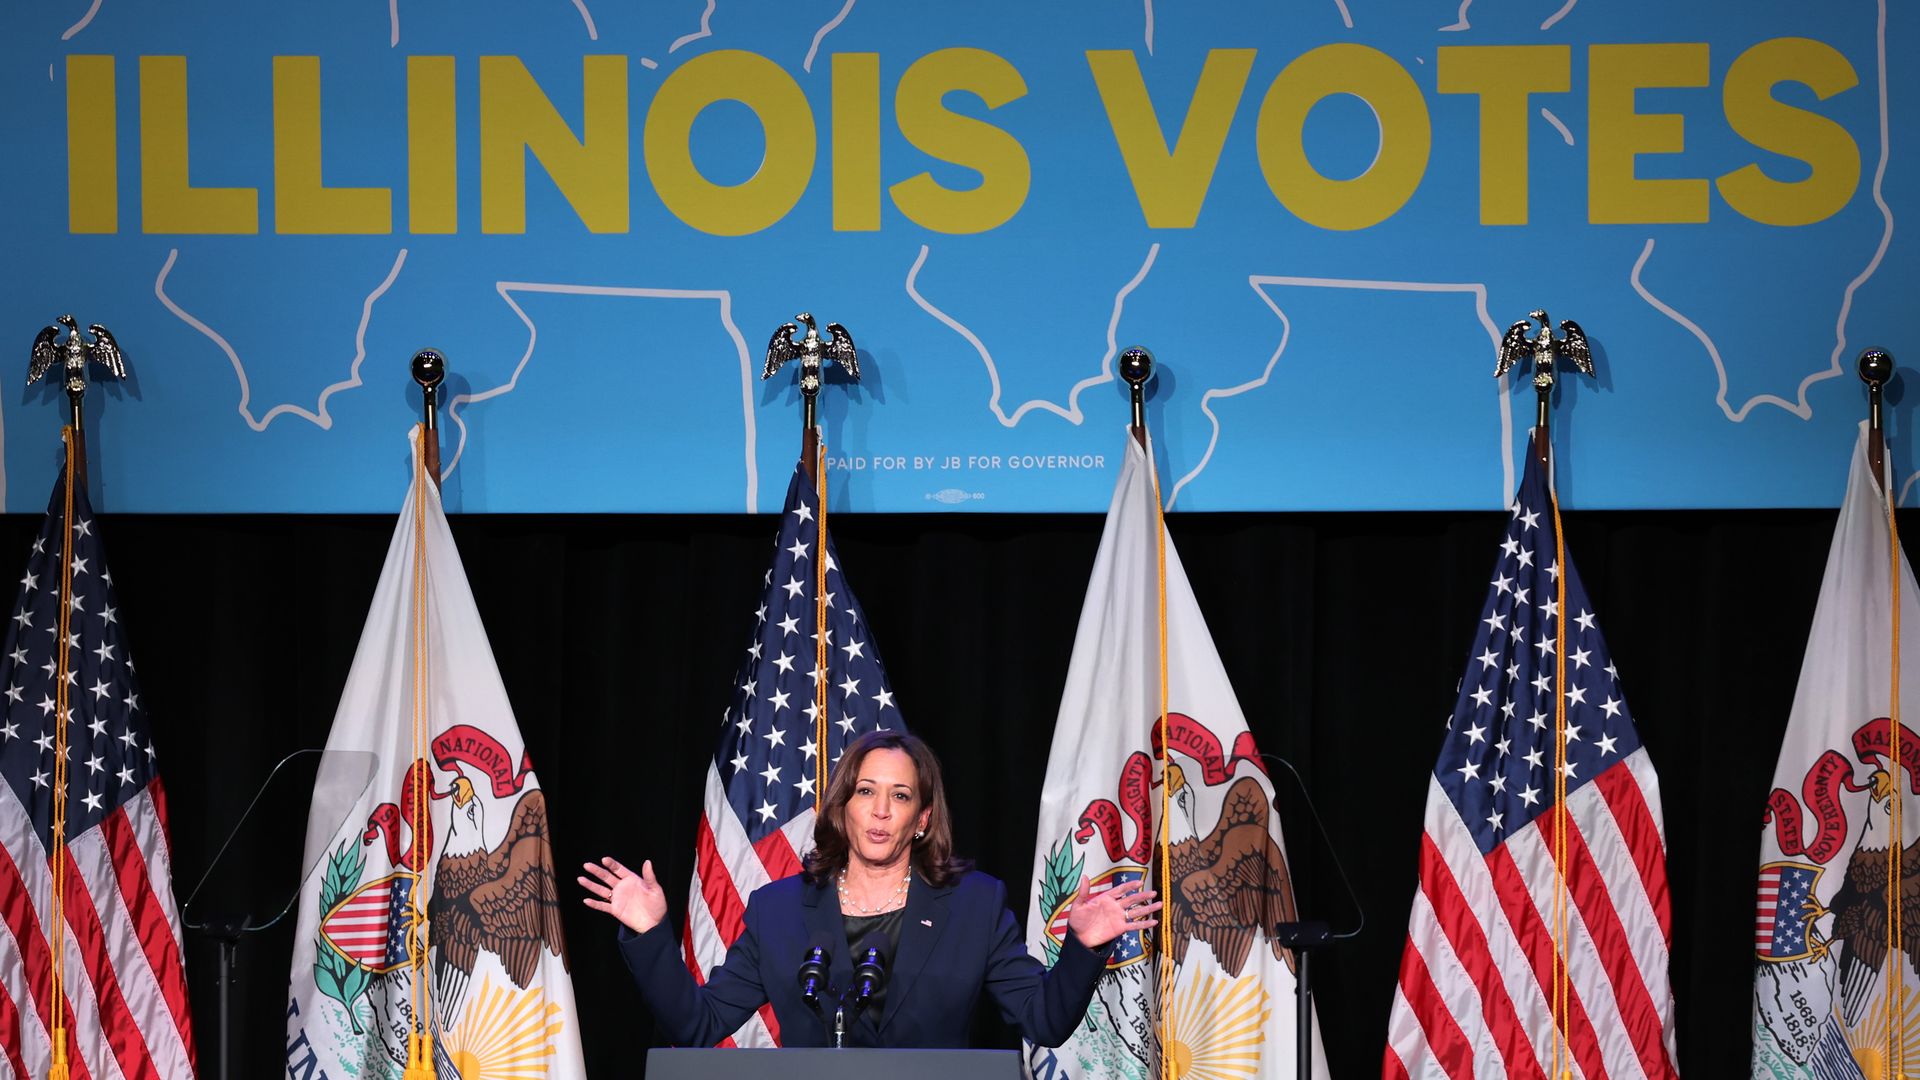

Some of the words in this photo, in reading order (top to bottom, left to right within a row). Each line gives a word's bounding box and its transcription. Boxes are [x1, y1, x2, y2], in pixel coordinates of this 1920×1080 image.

[67, 48, 1030, 236] ILLINOIS
[1087, 37, 1861, 231] VOTES
[827, 456, 866, 471] PAID
[873, 456, 906, 470] FOR
[914, 456, 934, 470] BY
[940, 456, 961, 470] JB
[968, 455, 1001, 470] FOR
[1008, 455, 1105, 470] GOVERNOR
[439, 737, 511, 791] NATIONAL
[1774, 794, 1799, 850] STATE
[1813, 755, 1840, 860] SOVEREIGNTY
[1129, 1015, 1150, 1049] 1818
[1783, 1012, 1808, 1048] 1818
[1790, 990, 1817, 1028] 1868
